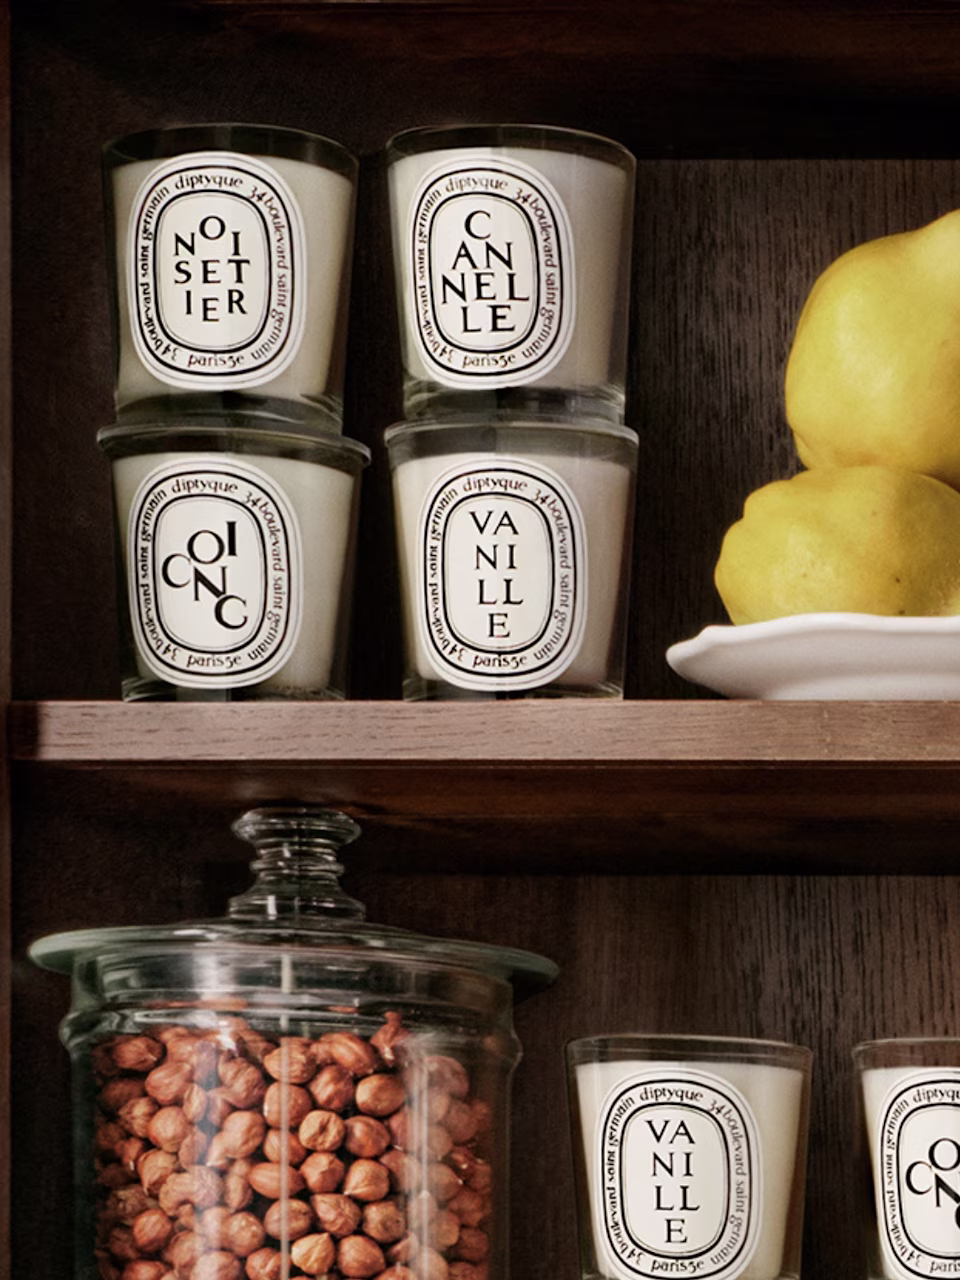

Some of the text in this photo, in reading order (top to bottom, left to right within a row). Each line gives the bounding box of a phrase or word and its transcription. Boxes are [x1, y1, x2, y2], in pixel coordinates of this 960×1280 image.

[174, 174, 243, 192] diptyque
[446, 177, 509, 194] diptyque
[172, 478, 238, 497] diptyque
[462, 476, 528, 495] diptyque
[639, 1086, 703, 1104] diptyque
